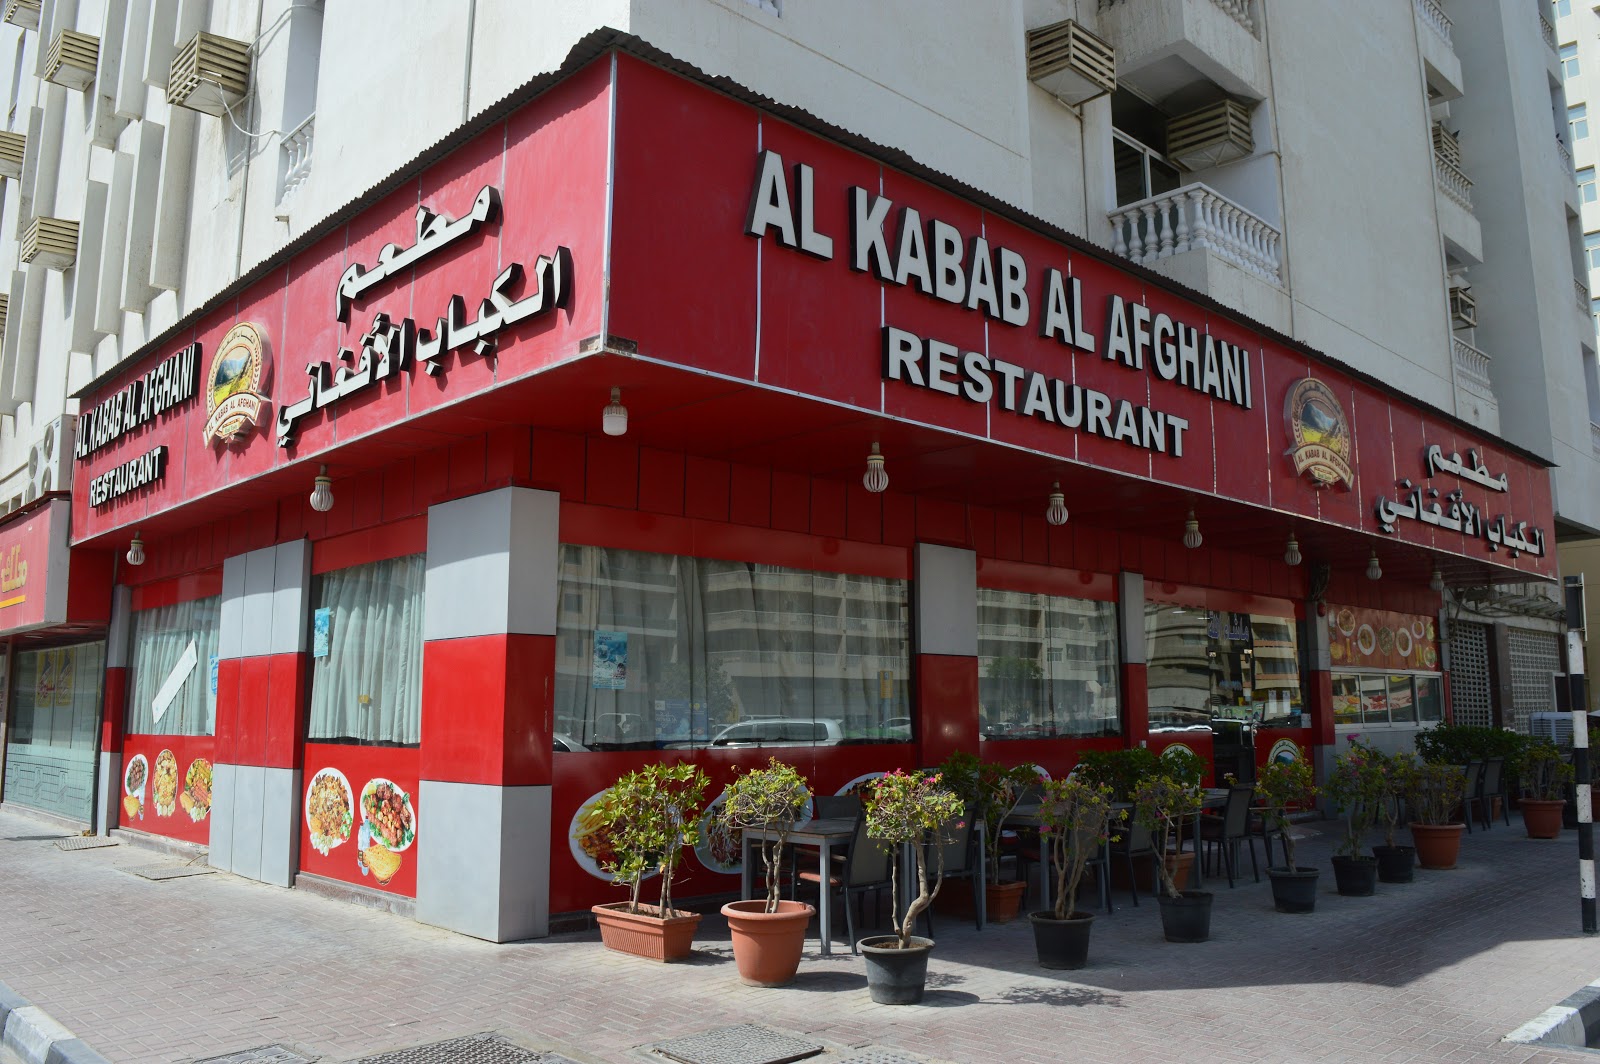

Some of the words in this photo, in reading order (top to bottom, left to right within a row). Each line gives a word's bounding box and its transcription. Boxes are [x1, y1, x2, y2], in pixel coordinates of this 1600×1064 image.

[335, 184, 498, 322] مطعم
[416, 245, 568, 377] الكباب
[745, 149, 834, 261] AL
[849, 186, 1030, 327] KABAB
[1040, 267, 1095, 353] AL
[1103, 294, 1252, 409] AFGHANI
[75, 413, 91, 460] AL
[89, 391, 125, 453] KABAB
[123, 380, 142, 432] AL
[139, 342, 201, 415] AFGHANI
[882, 326, 1189, 458] RESTAURANT
[90, 446, 168, 507] RESTAURANT
[1425, 444, 1508, 493] مطعم
[1484, 514, 1545, 558] الكباب
